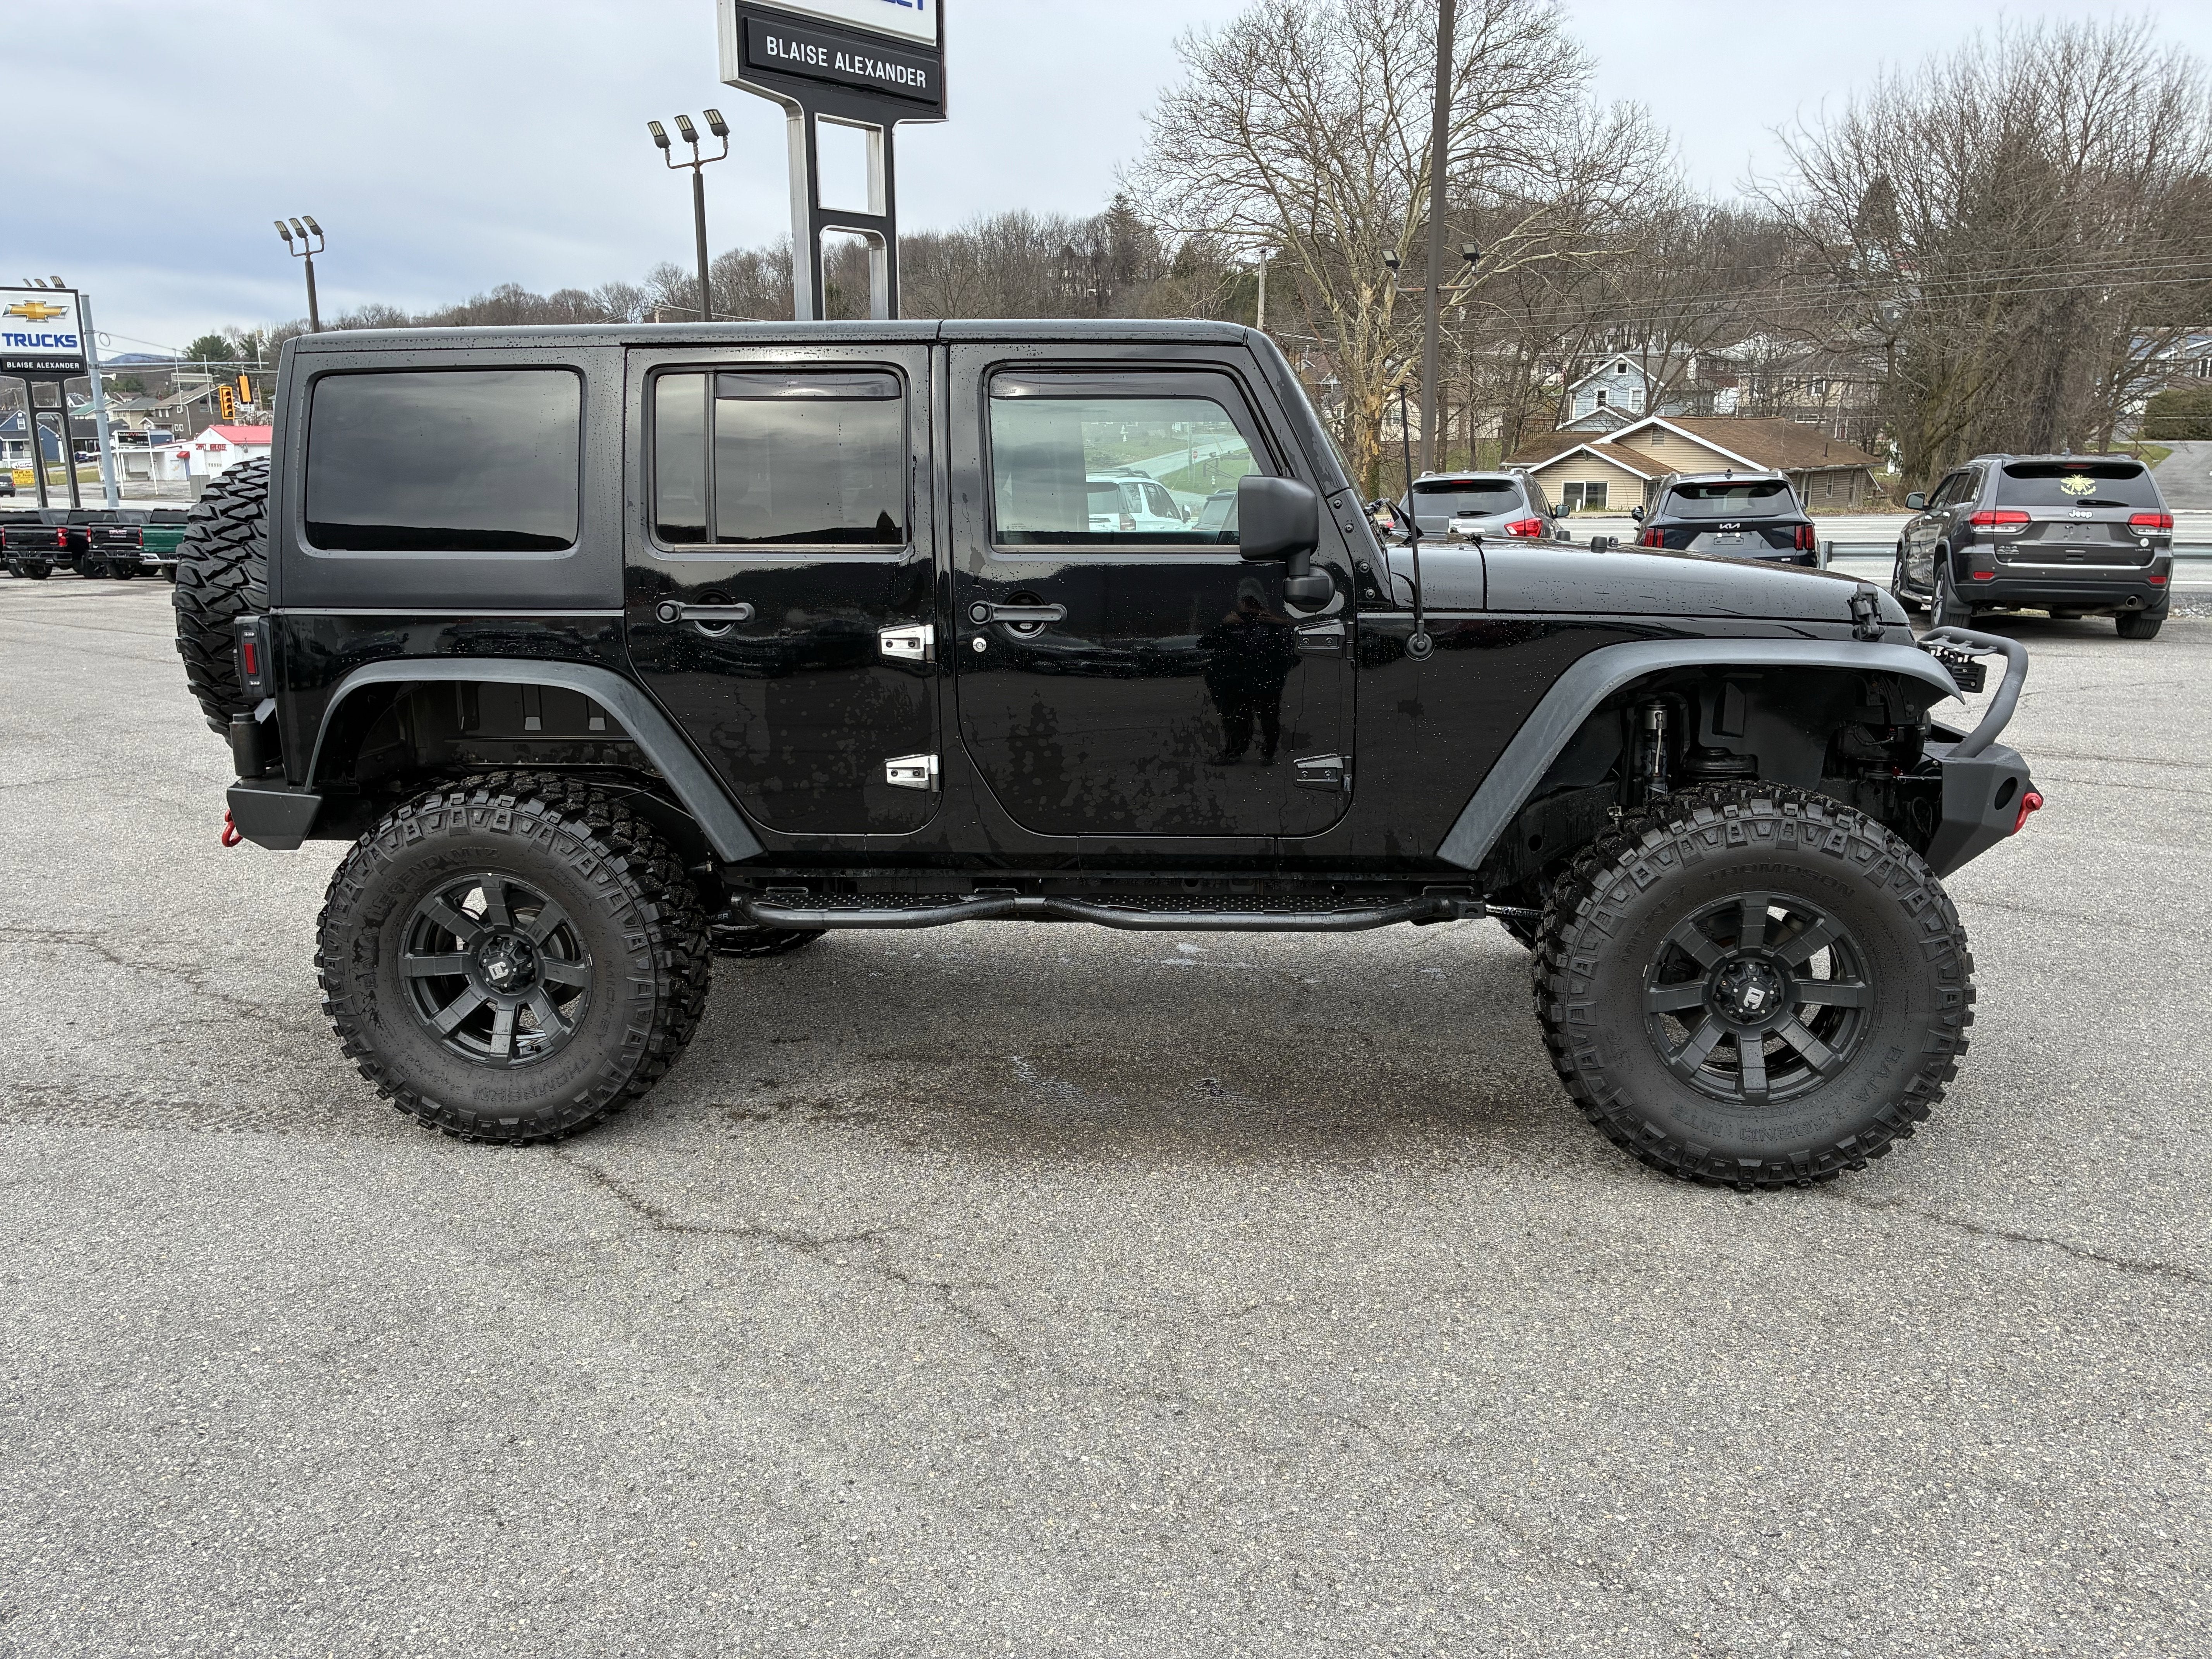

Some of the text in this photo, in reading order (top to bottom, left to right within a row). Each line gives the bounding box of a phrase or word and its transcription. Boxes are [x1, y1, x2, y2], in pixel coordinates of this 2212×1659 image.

[766, 36, 926, 88] BLAISE ALEXANDER
[2, 333, 77, 348] TRUCKS
[2069, 510, 2093, 519] Jeep
[1704, 862, 1856, 898] THOMPSON
[595, 959, 617, 1046] MICKEY
